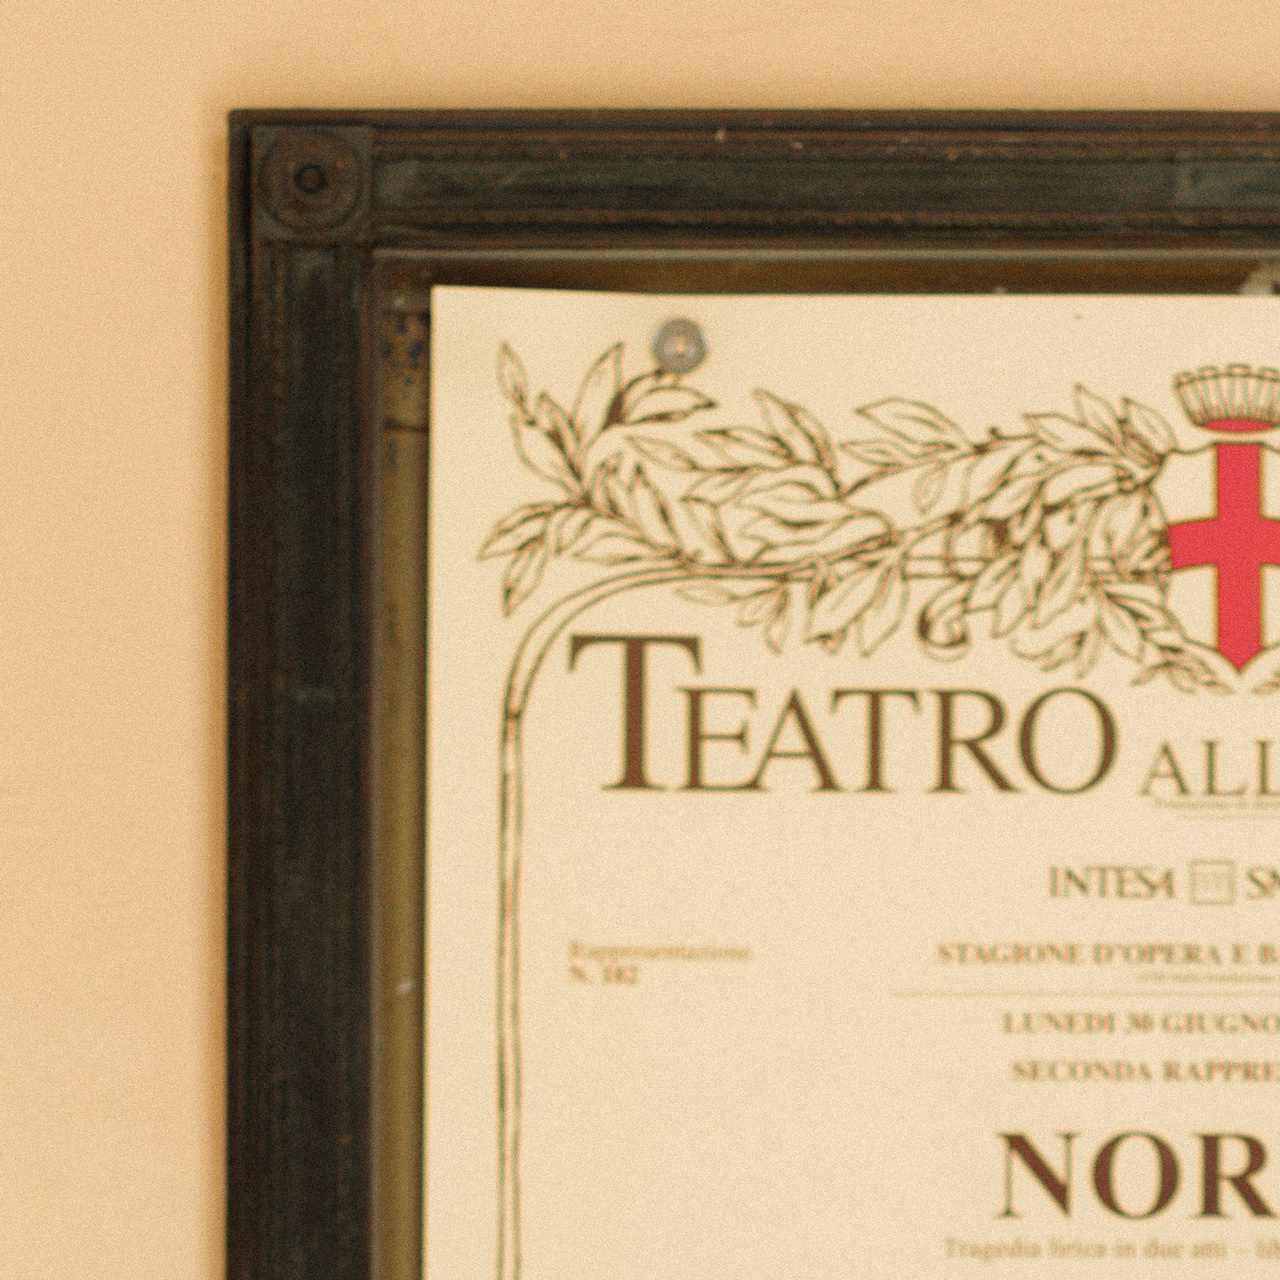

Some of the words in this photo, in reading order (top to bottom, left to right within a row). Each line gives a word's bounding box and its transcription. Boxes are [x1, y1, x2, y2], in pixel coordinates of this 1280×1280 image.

[568, 634, 1119, 795] TEATRO
[1049, 865, 1176, 899] INTESA
[937, 942, 1083, 965] STAGIONE
[1231, 943, 1246, 965] E
[1126, 1013, 1155, 1034] 30
[1011, 1059, 1153, 1082] SECONDA
[944, 1236, 1043, 1264] Tragedia
[1112, 1239, 1137, 1259] in
